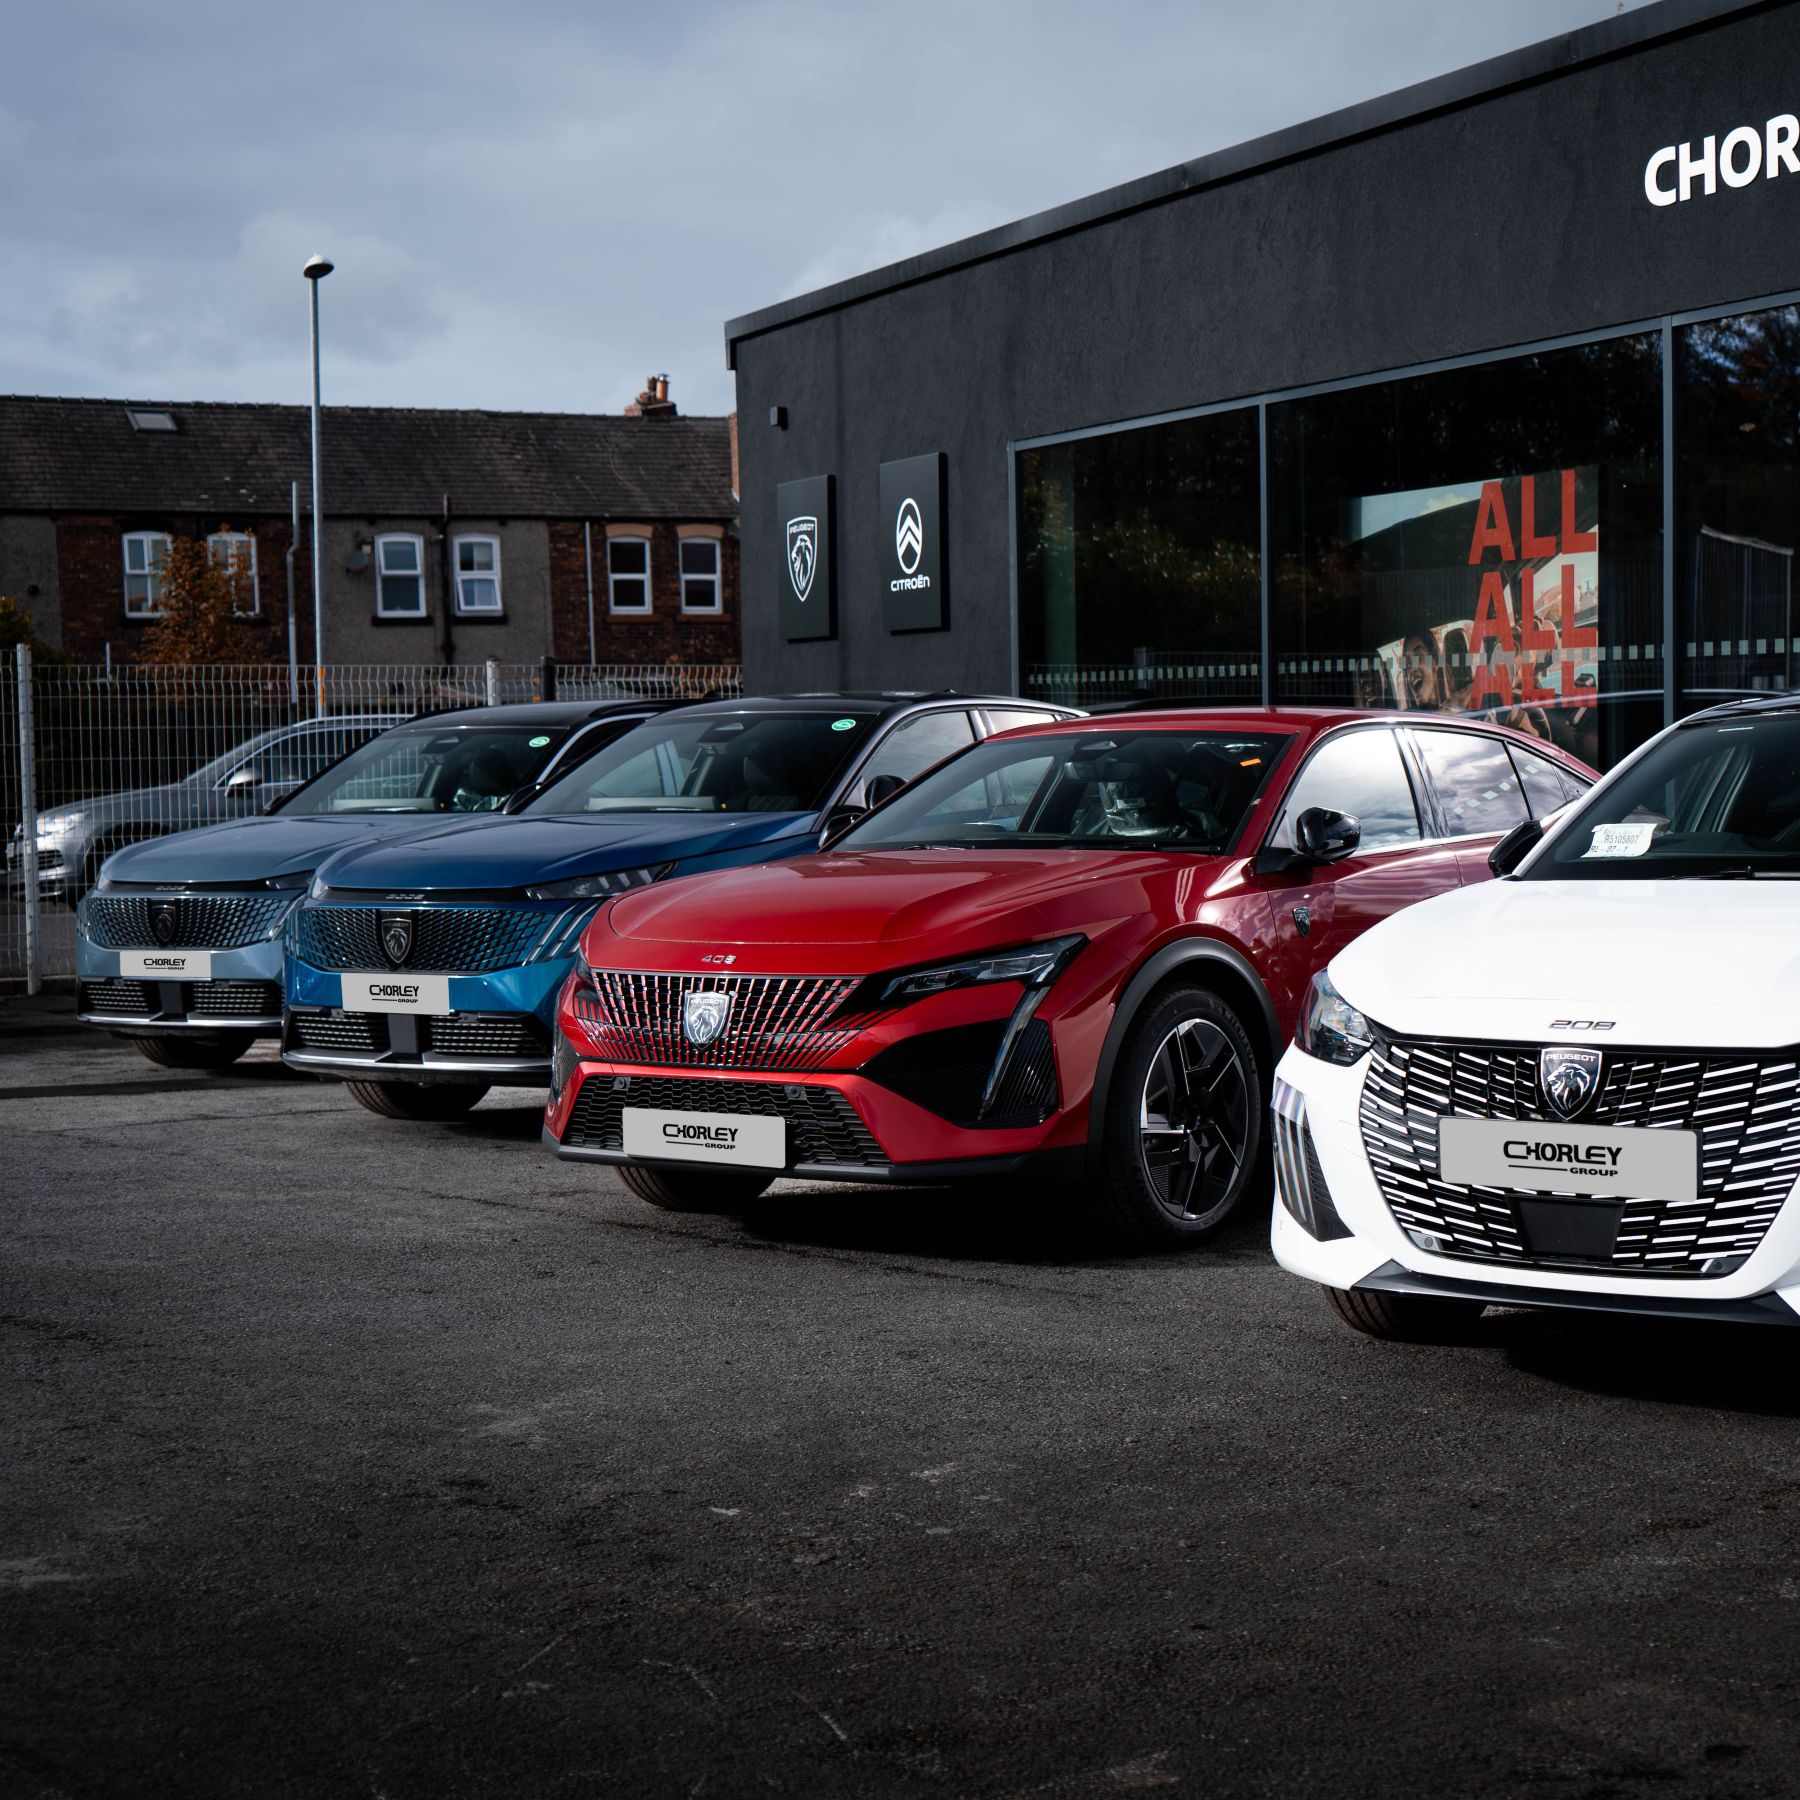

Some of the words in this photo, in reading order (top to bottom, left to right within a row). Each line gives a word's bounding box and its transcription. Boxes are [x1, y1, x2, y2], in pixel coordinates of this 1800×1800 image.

[1468, 469, 1598, 566] ALL
[1468, 564, 1598, 654] ALL
[143, 958, 187, 967] CHORLEY
[369, 984, 420, 998] CHORLEY
[1548, 1019, 1617, 1031] 208
[1546, 1053, 1597, 1063] PEUGEOT
[662, 1123, 739, 1142] CHORLEY
[704, 1142, 736, 1150] GROUP
[1503, 1140, 1623, 1166] CHORLEY
[1569, 1167, 1619, 1177] GROUP
